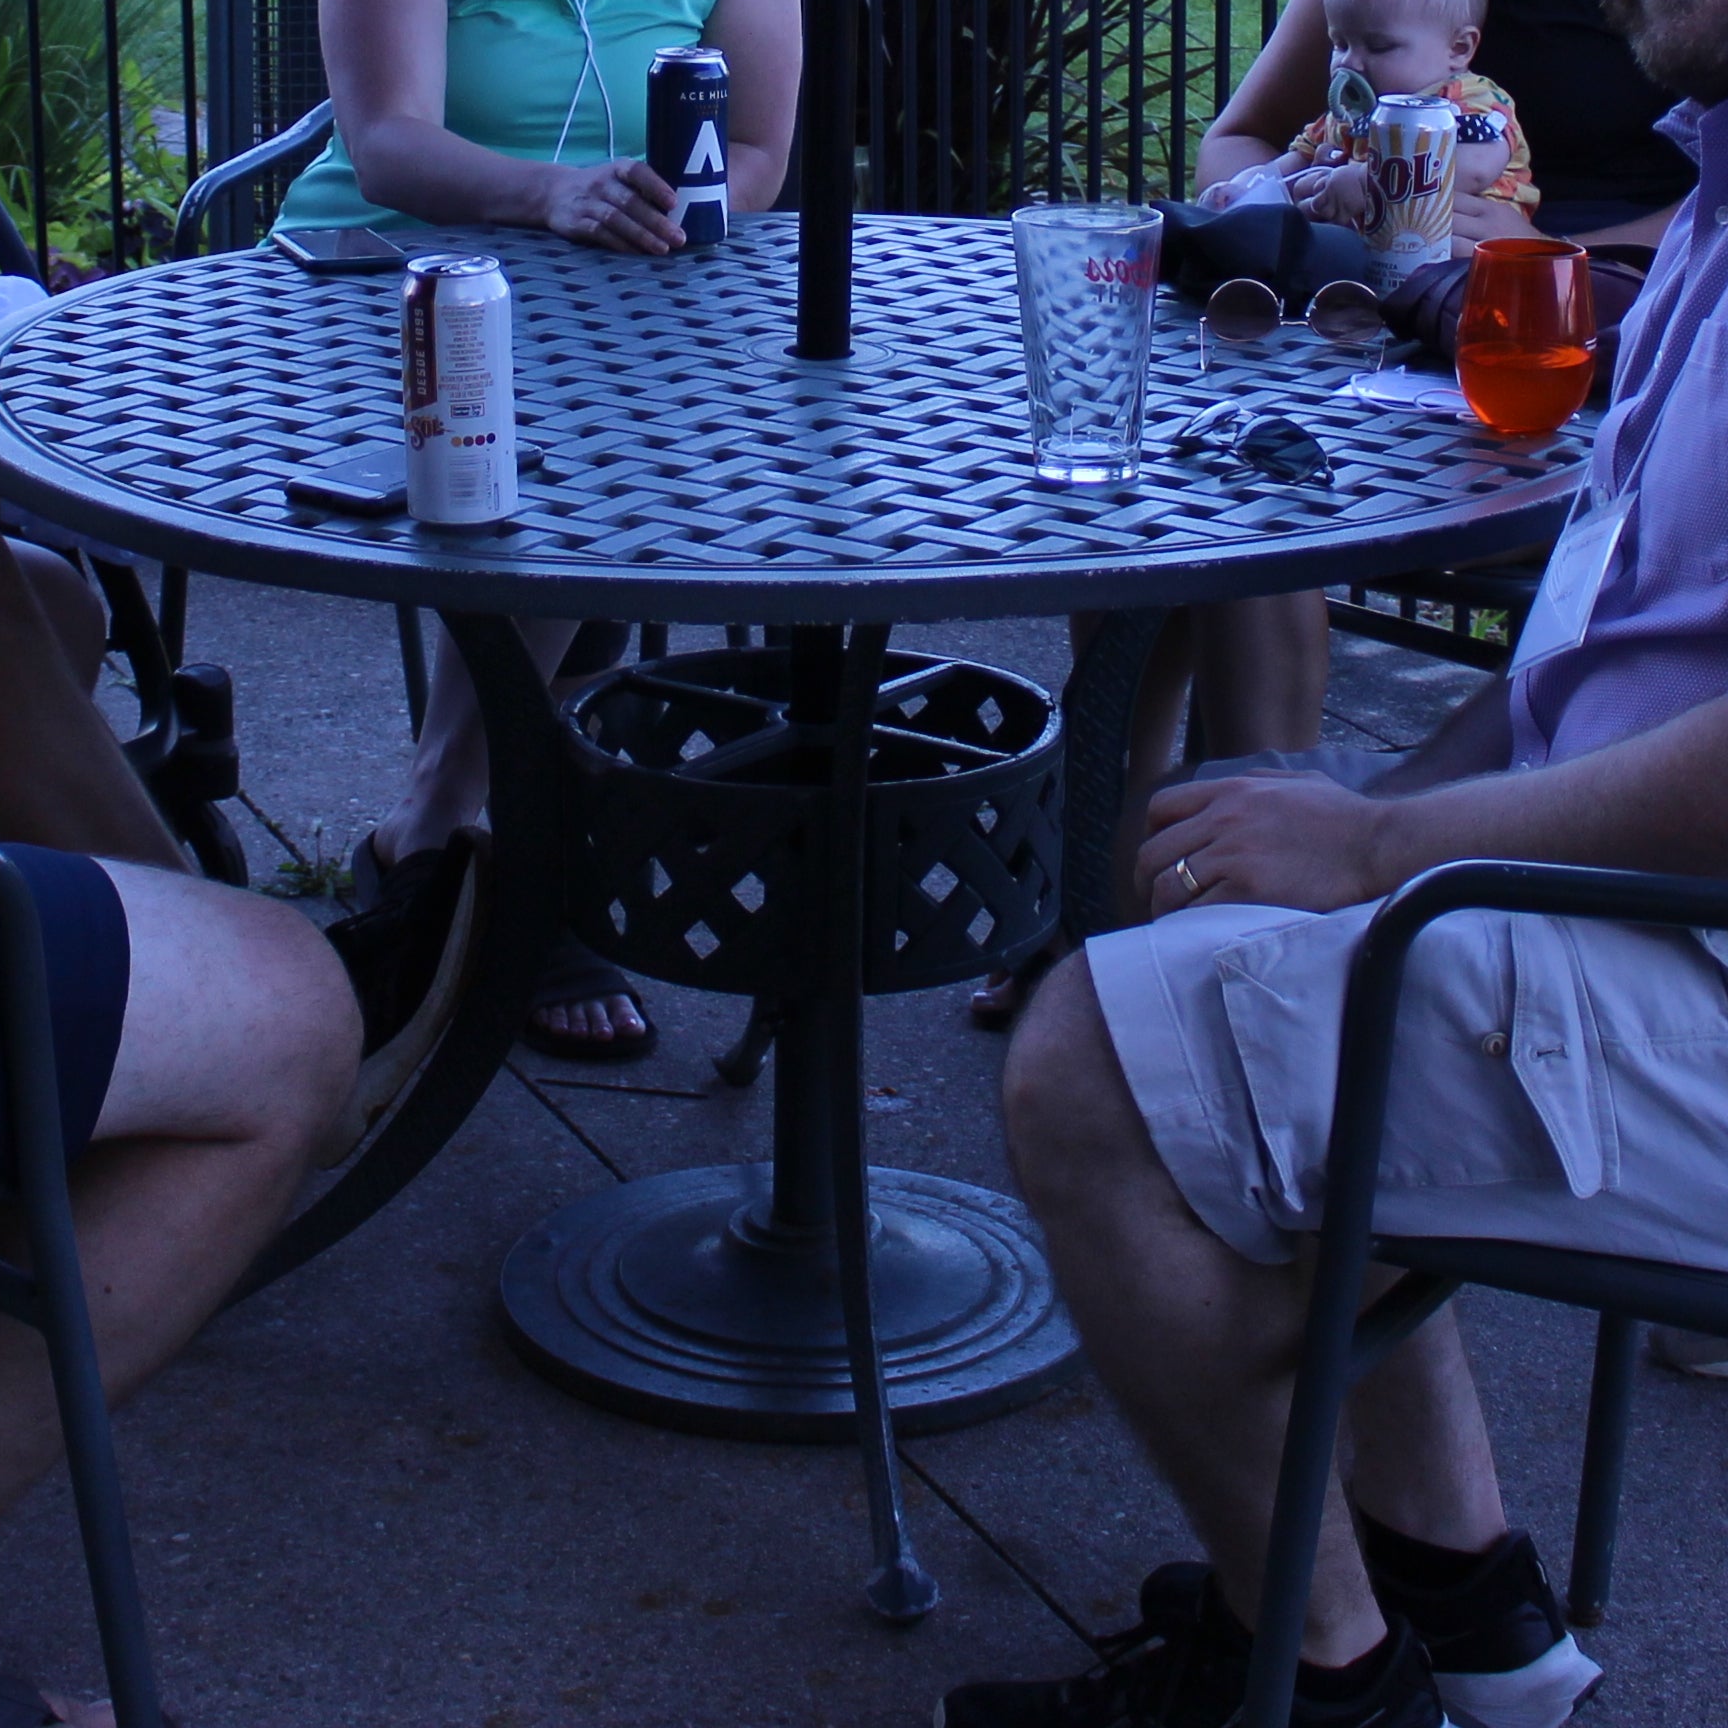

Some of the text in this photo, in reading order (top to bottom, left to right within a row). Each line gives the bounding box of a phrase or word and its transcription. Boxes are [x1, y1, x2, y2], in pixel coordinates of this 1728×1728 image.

[680, 88, 728, 101] ACE HILL
[414, 308, 428, 396] DESDE 1899
